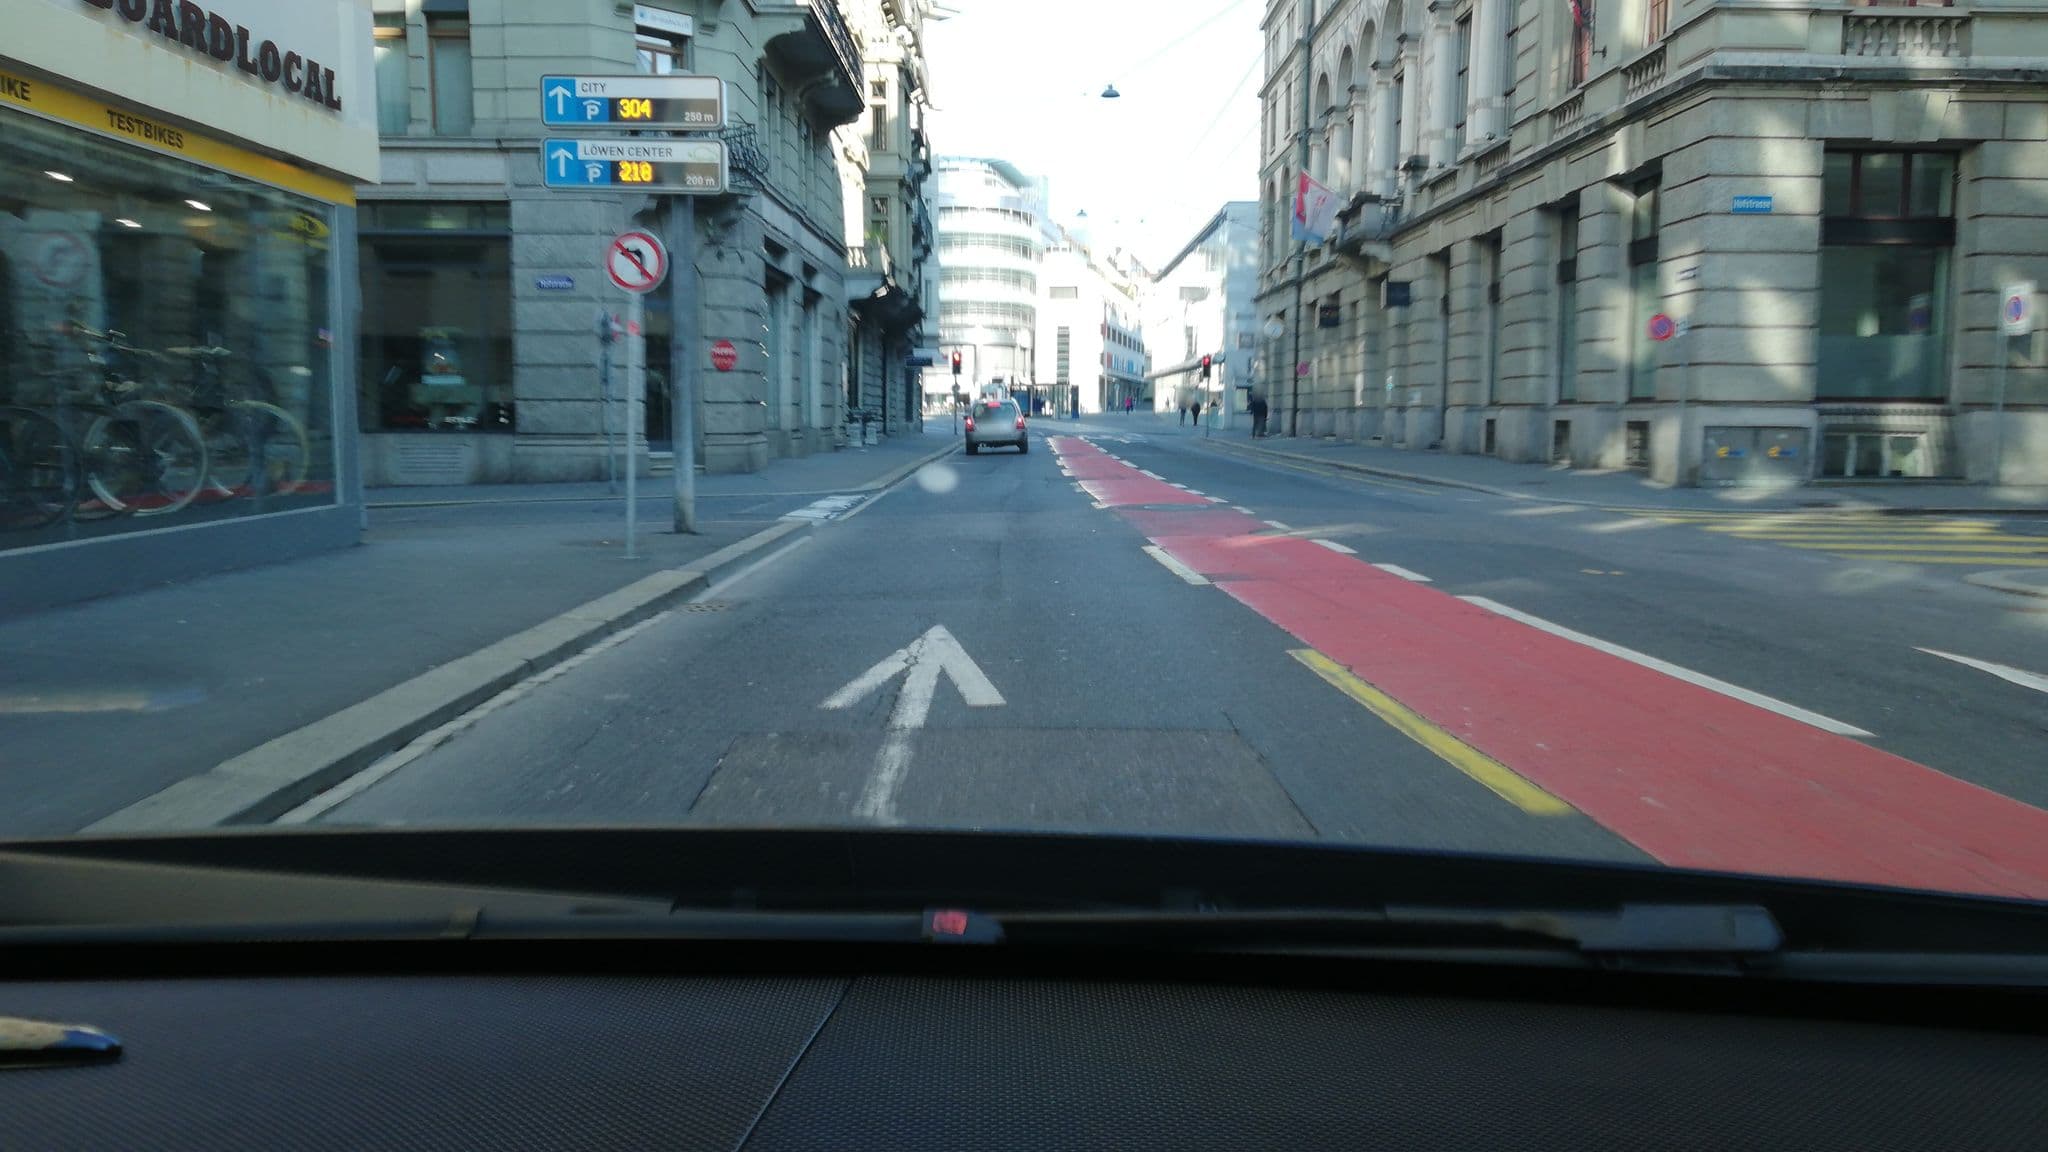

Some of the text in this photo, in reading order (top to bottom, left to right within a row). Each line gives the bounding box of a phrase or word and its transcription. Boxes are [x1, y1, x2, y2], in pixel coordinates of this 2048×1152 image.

[82, 0, 342, 112] ARDLOCAL
[581, 82, 606, 93] CITY
[619, 99, 653, 119] 304
[684, 111, 714, 122] 250 m
[106, 108, 184, 149] TESTBIKES
[583, 144, 673, 158] LÖWEN CENTER
[705, 177, 715, 186] m
